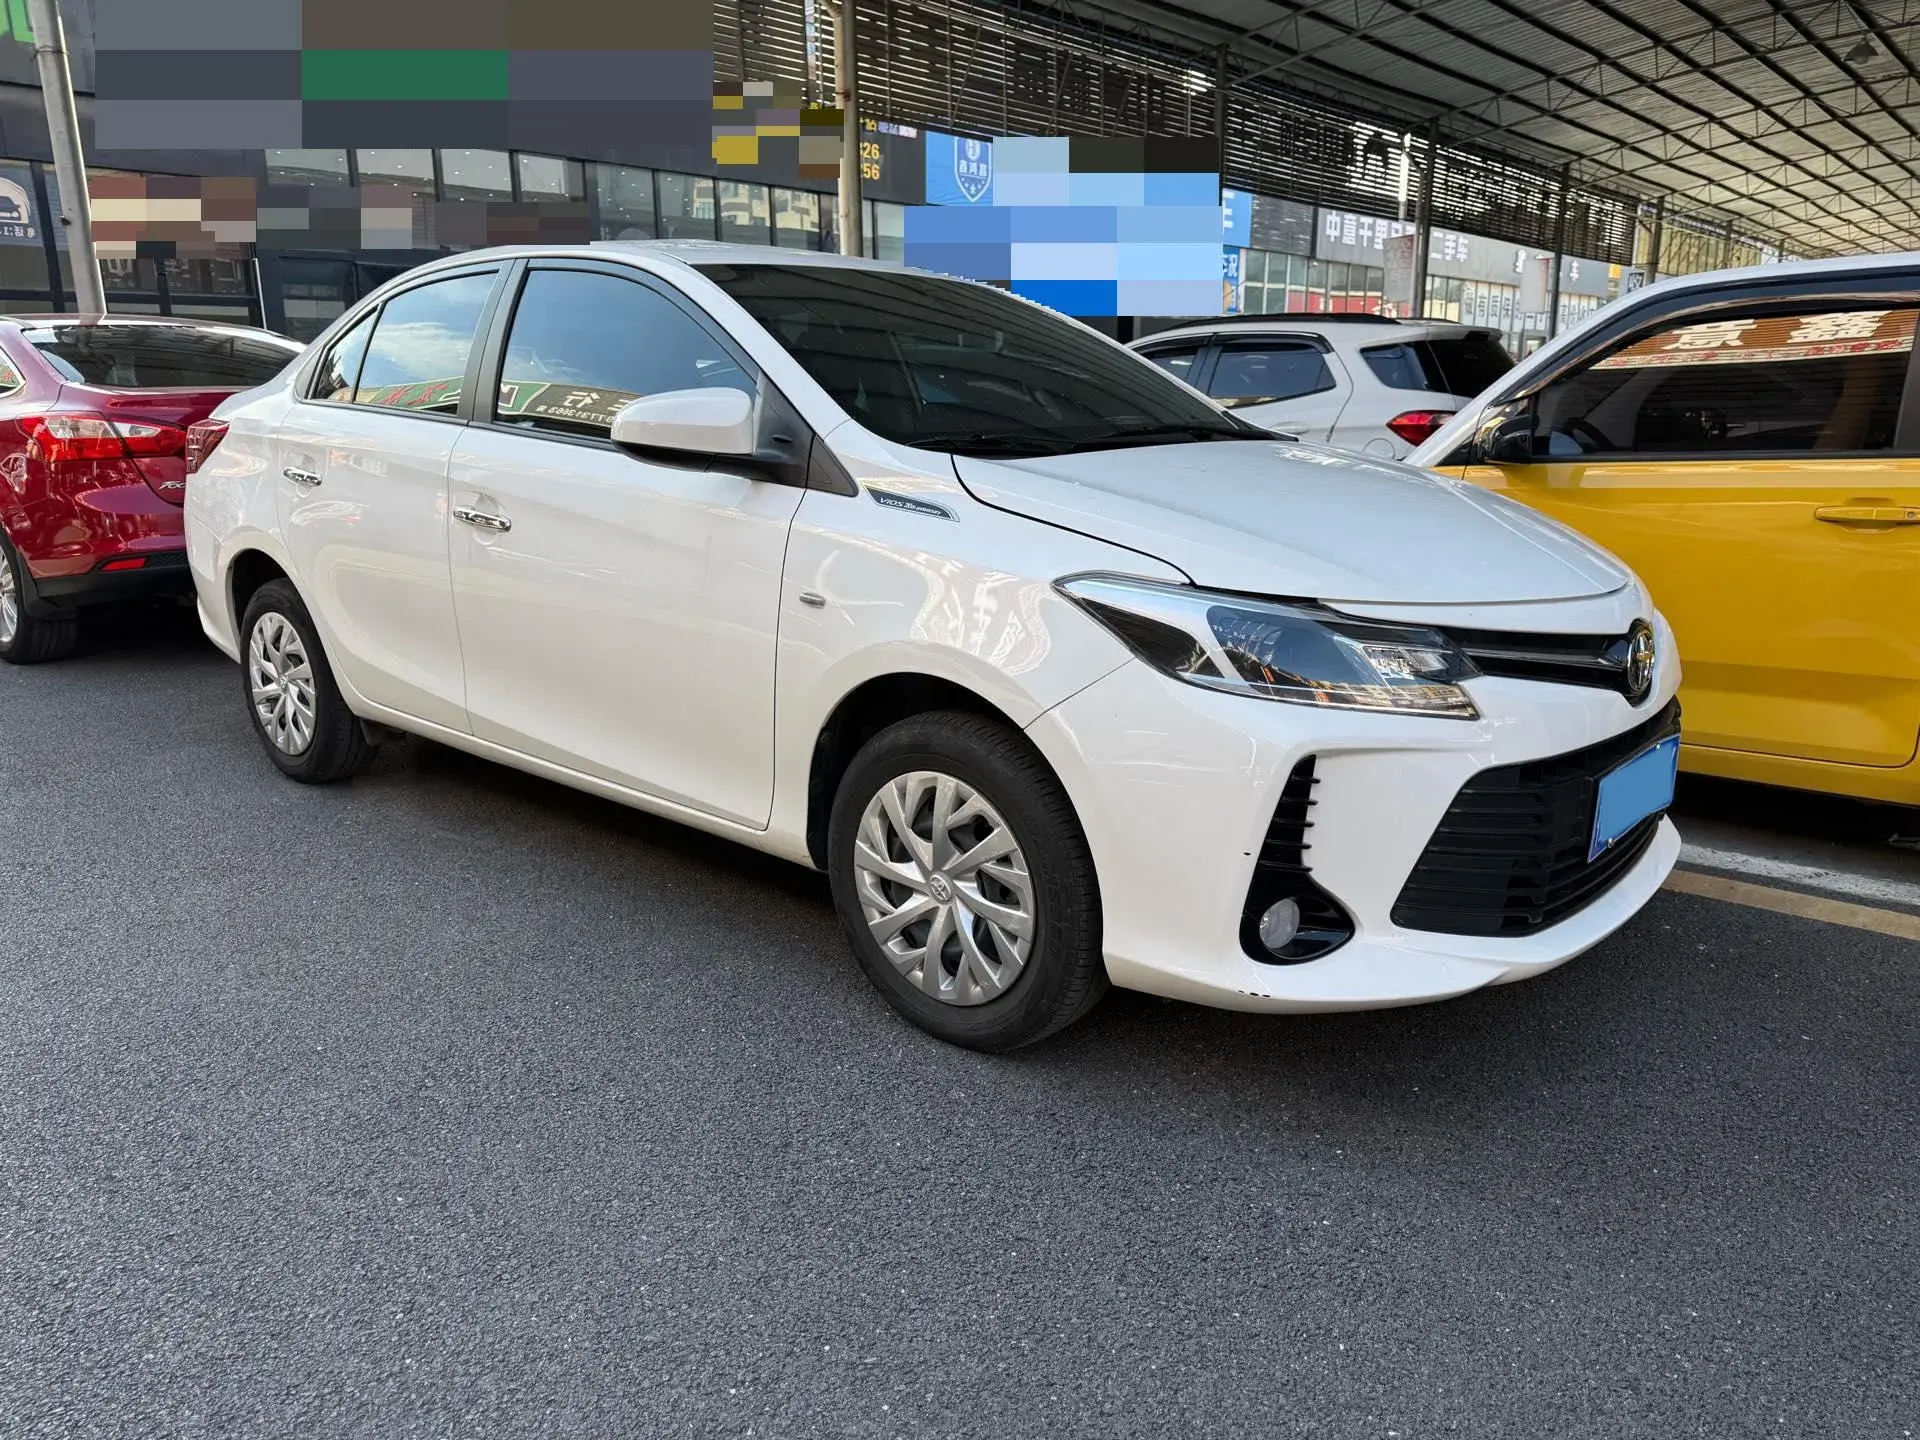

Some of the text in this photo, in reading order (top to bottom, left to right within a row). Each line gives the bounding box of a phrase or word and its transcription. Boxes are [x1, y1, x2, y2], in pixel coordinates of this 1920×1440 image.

[860, 142, 880, 160] 26
[860, 162, 880, 180] 56
[880, 497, 904, 507] VIOS
